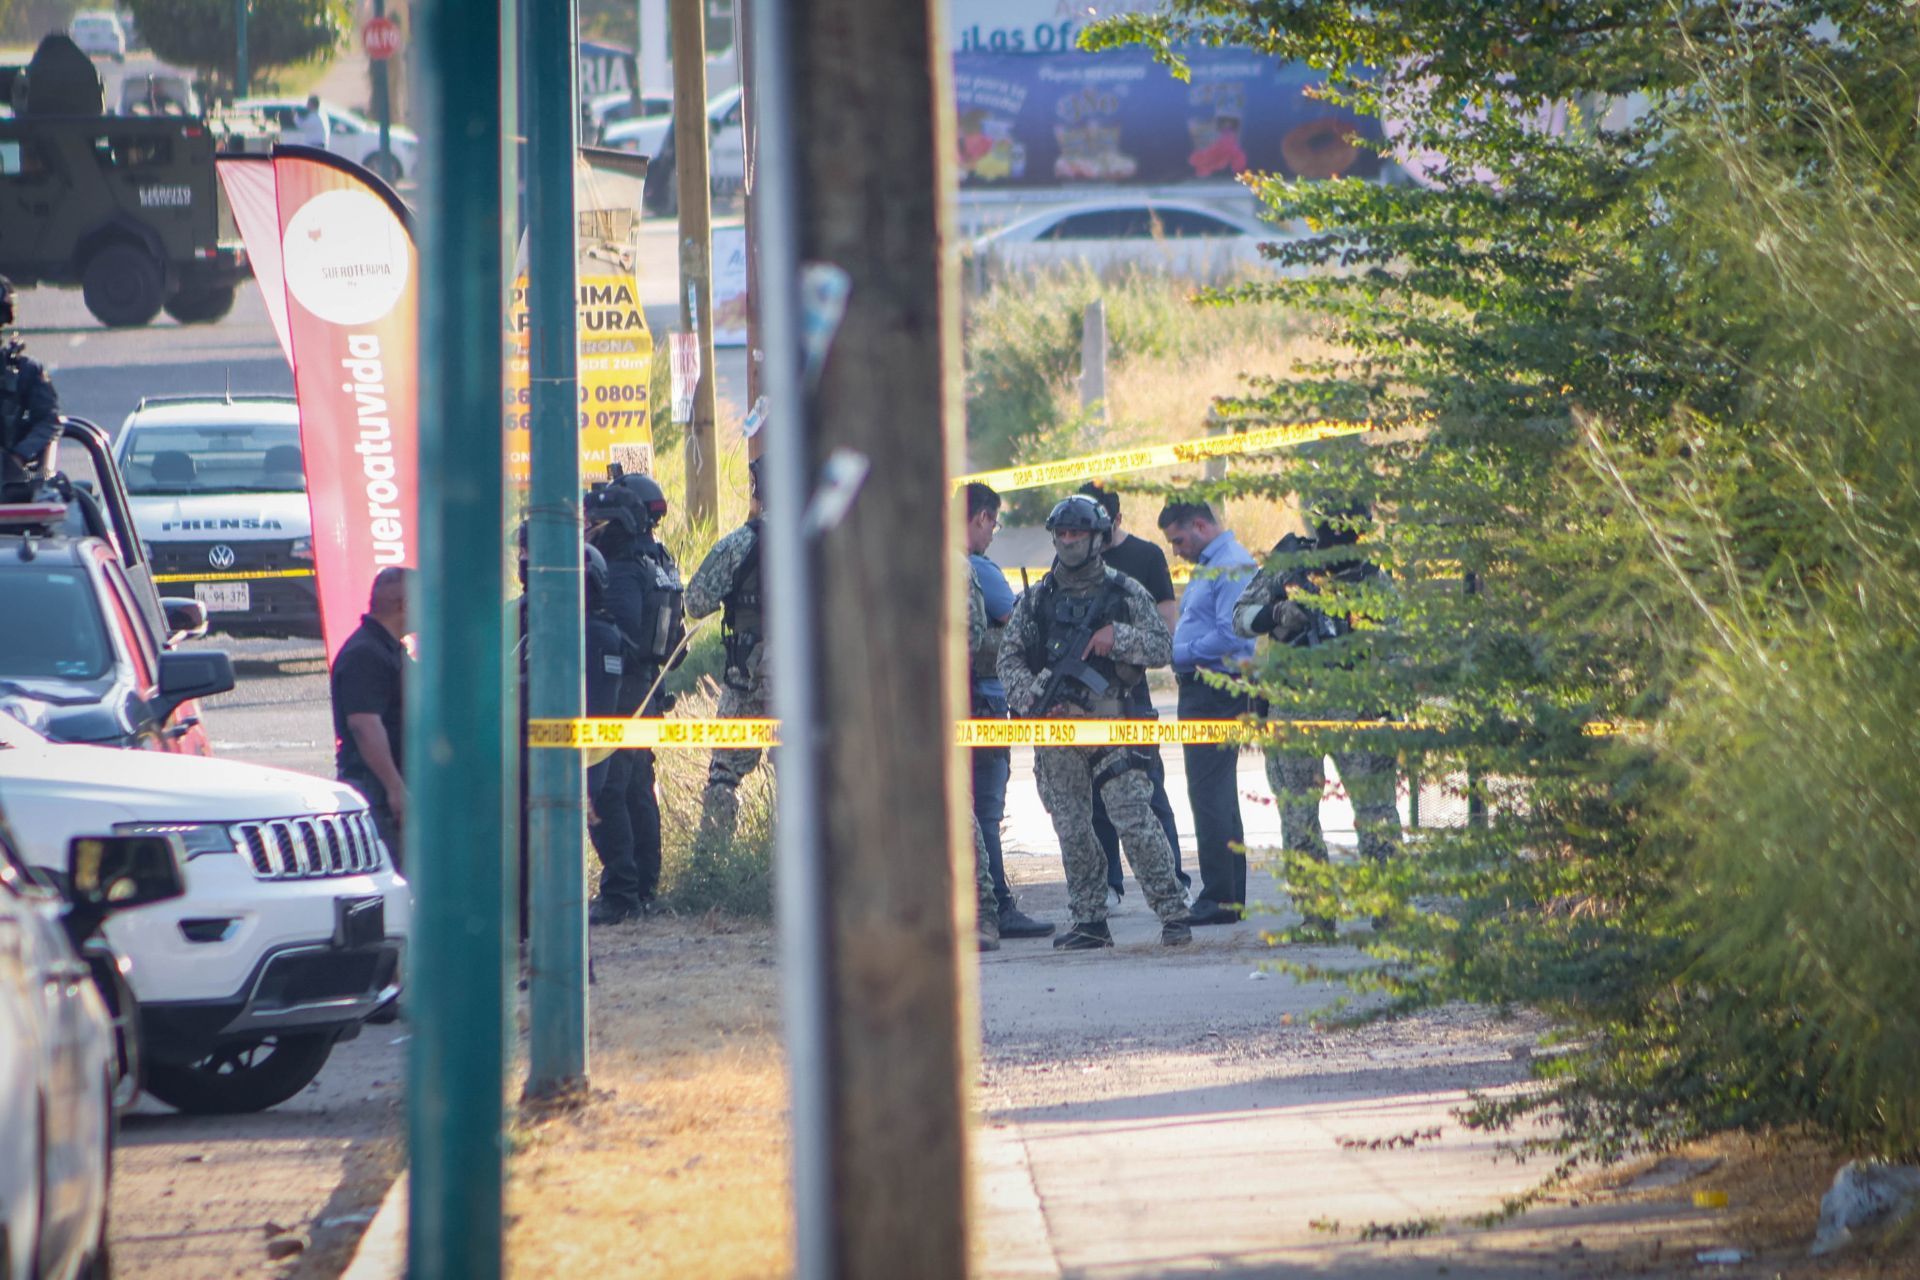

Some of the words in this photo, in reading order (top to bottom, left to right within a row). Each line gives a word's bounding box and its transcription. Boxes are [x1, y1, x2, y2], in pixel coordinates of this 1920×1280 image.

[366, 29, 400, 48] ALTO
[579, 58, 629, 94] RIA
[321, 263, 391, 280] SUEROTERAPIA
[595, 385, 647, 403] 0805
[595, 410, 647, 428] 0777
[341, 333, 406, 574] ueroatuvida
[162, 518, 282, 531] PRENSA
[582, 723, 593, 743] EL
[598, 723, 624, 743] PASO
[658, 723, 688, 743] LINEA
[691, 723, 704, 743] DE
[708, 723, 747, 743] POLICIA
[976, 724, 1032, 742] PROHIBIDO
[1034, 725, 1046, 742] EL
[1050, 725, 1076, 742] PASO
[1109, 724, 1139, 742] LINEA
[1141, 724, 1155, 742] DE
[1158, 724, 1197, 742] POLICIA
